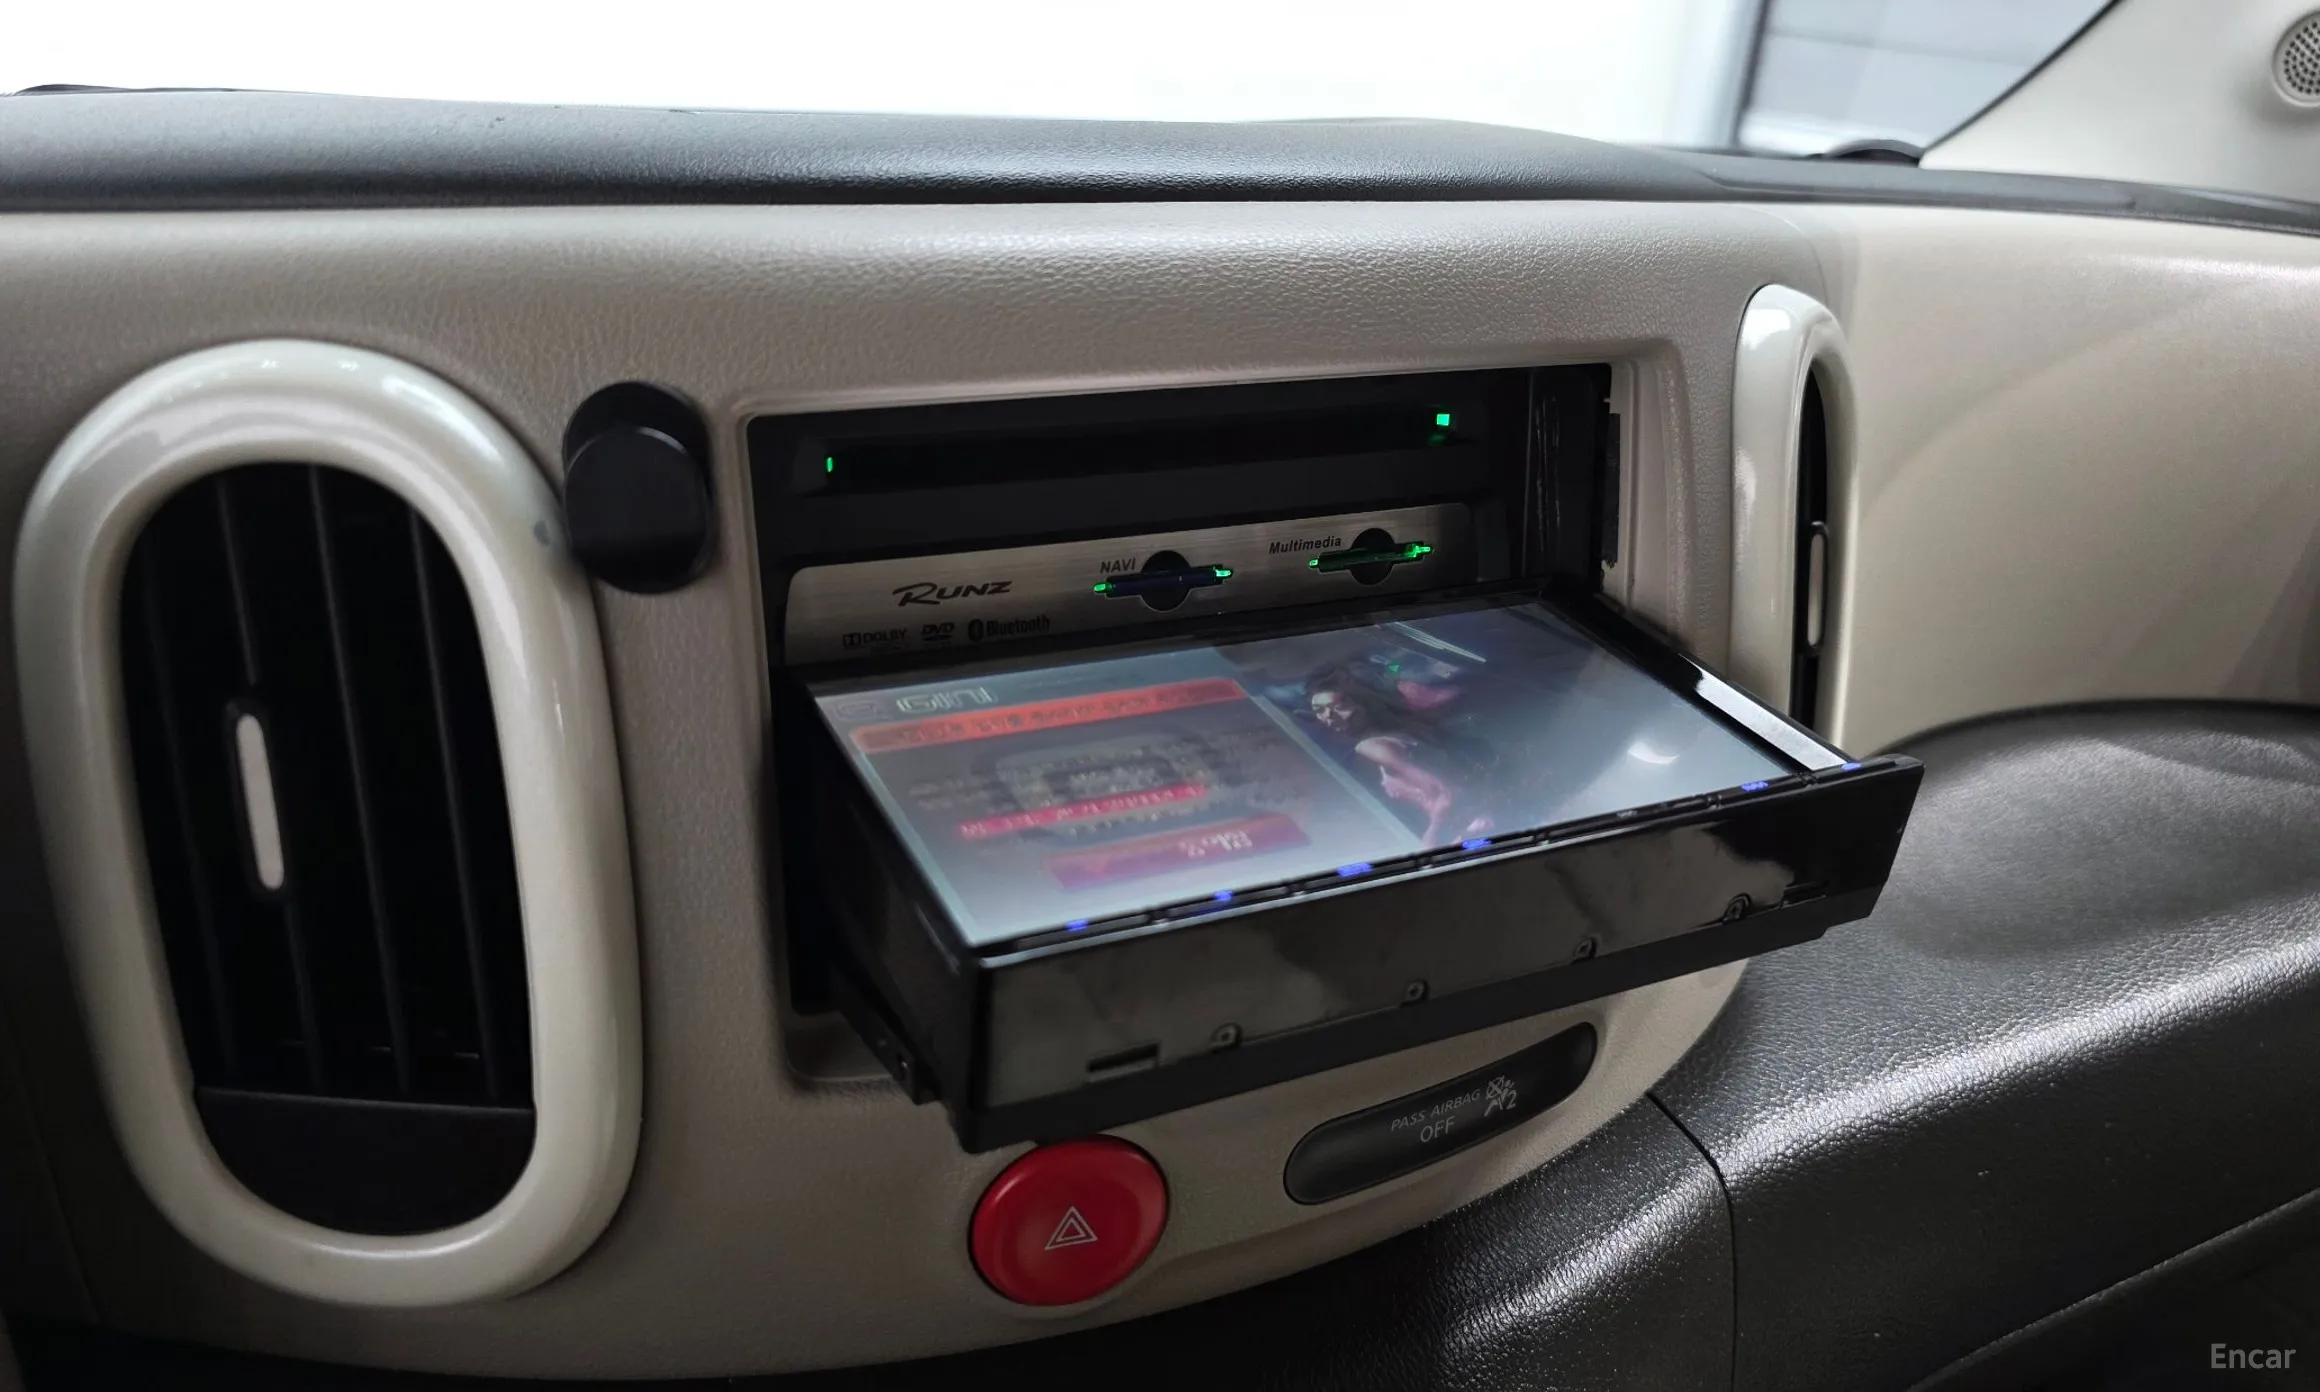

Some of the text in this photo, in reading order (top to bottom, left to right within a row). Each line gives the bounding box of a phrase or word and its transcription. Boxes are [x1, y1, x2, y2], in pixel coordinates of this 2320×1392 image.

[1268, 535, 1342, 555] Multimedia
[1100, 557, 1137, 574] NAVI
[921, 621, 955, 637] DVD
[985, 614, 1050, 637] Bluetooth
[864, 628, 907, 644] DOLBY
[1390, 1088, 1481, 1132] PASS AIRBAG
[1419, 1116, 1457, 1144] OFF
